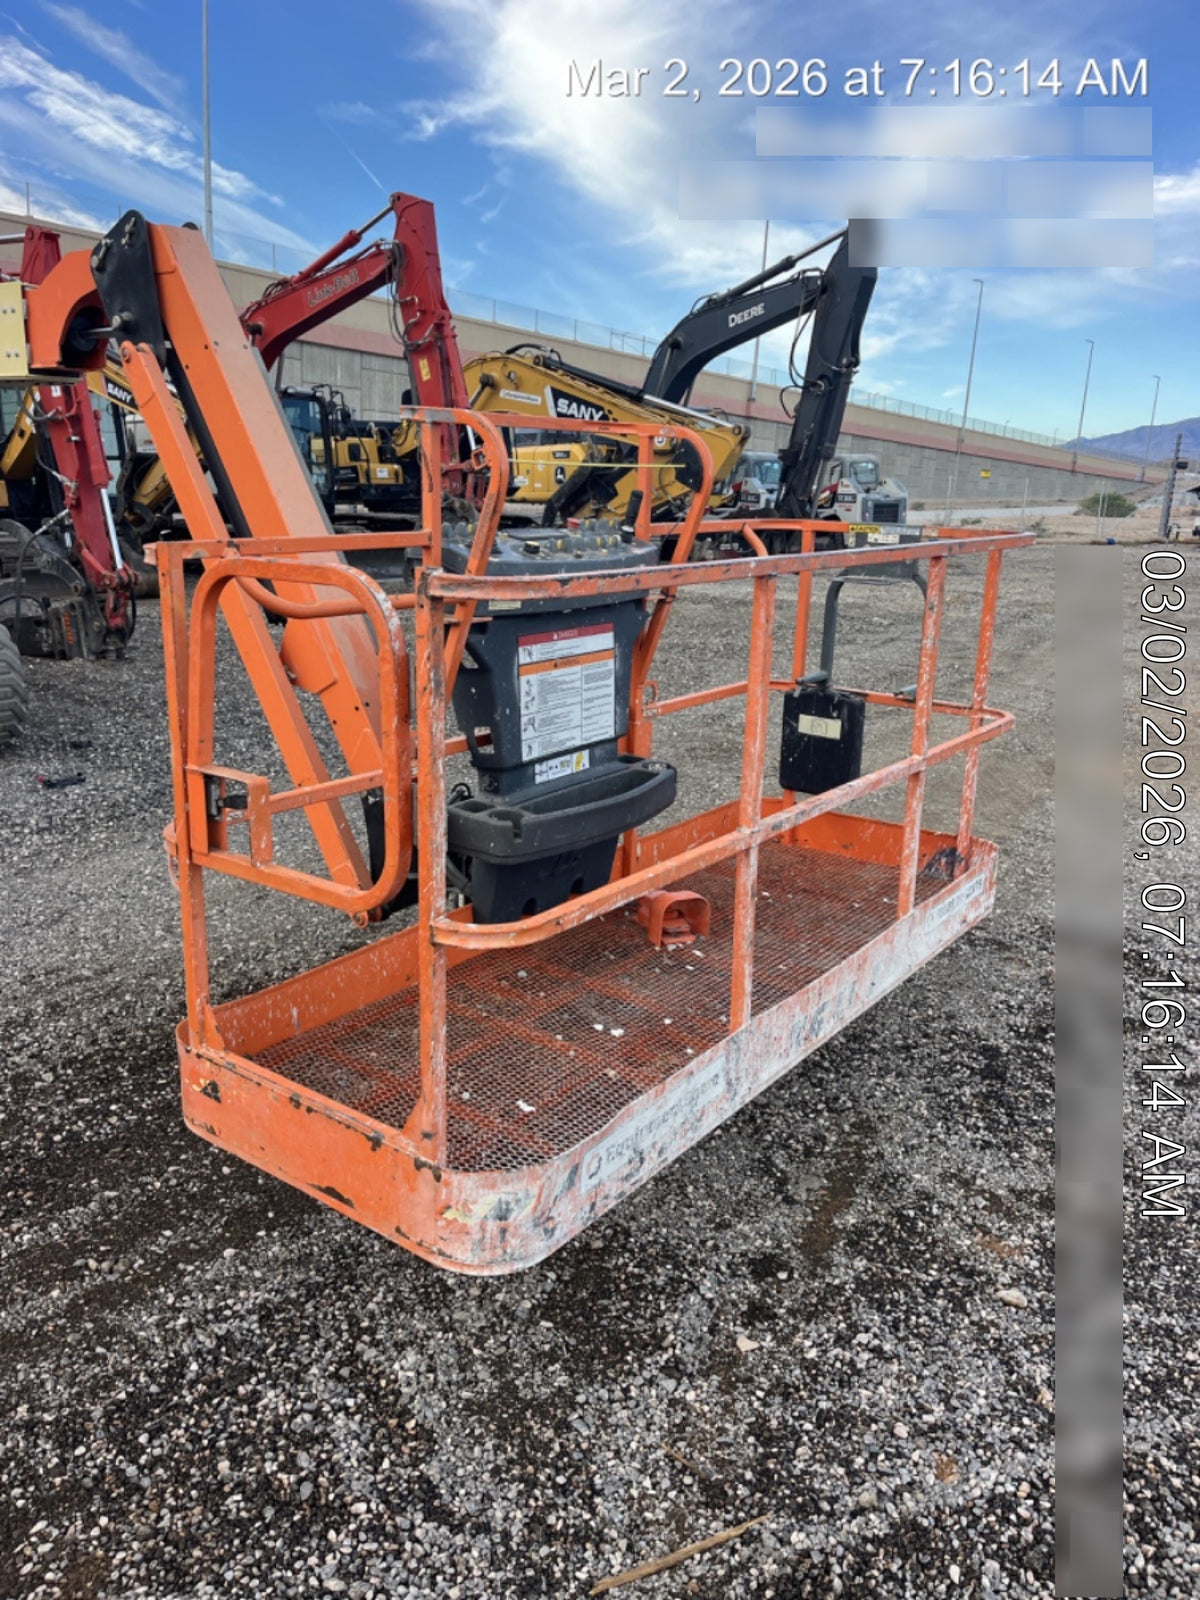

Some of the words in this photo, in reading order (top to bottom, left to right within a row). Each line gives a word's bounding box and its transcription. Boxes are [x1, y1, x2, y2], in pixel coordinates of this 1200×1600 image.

[728, 302, 765, 328] DEERE
[107, 382, 133, 403] SANY
[557, 398, 603, 421] SANY
